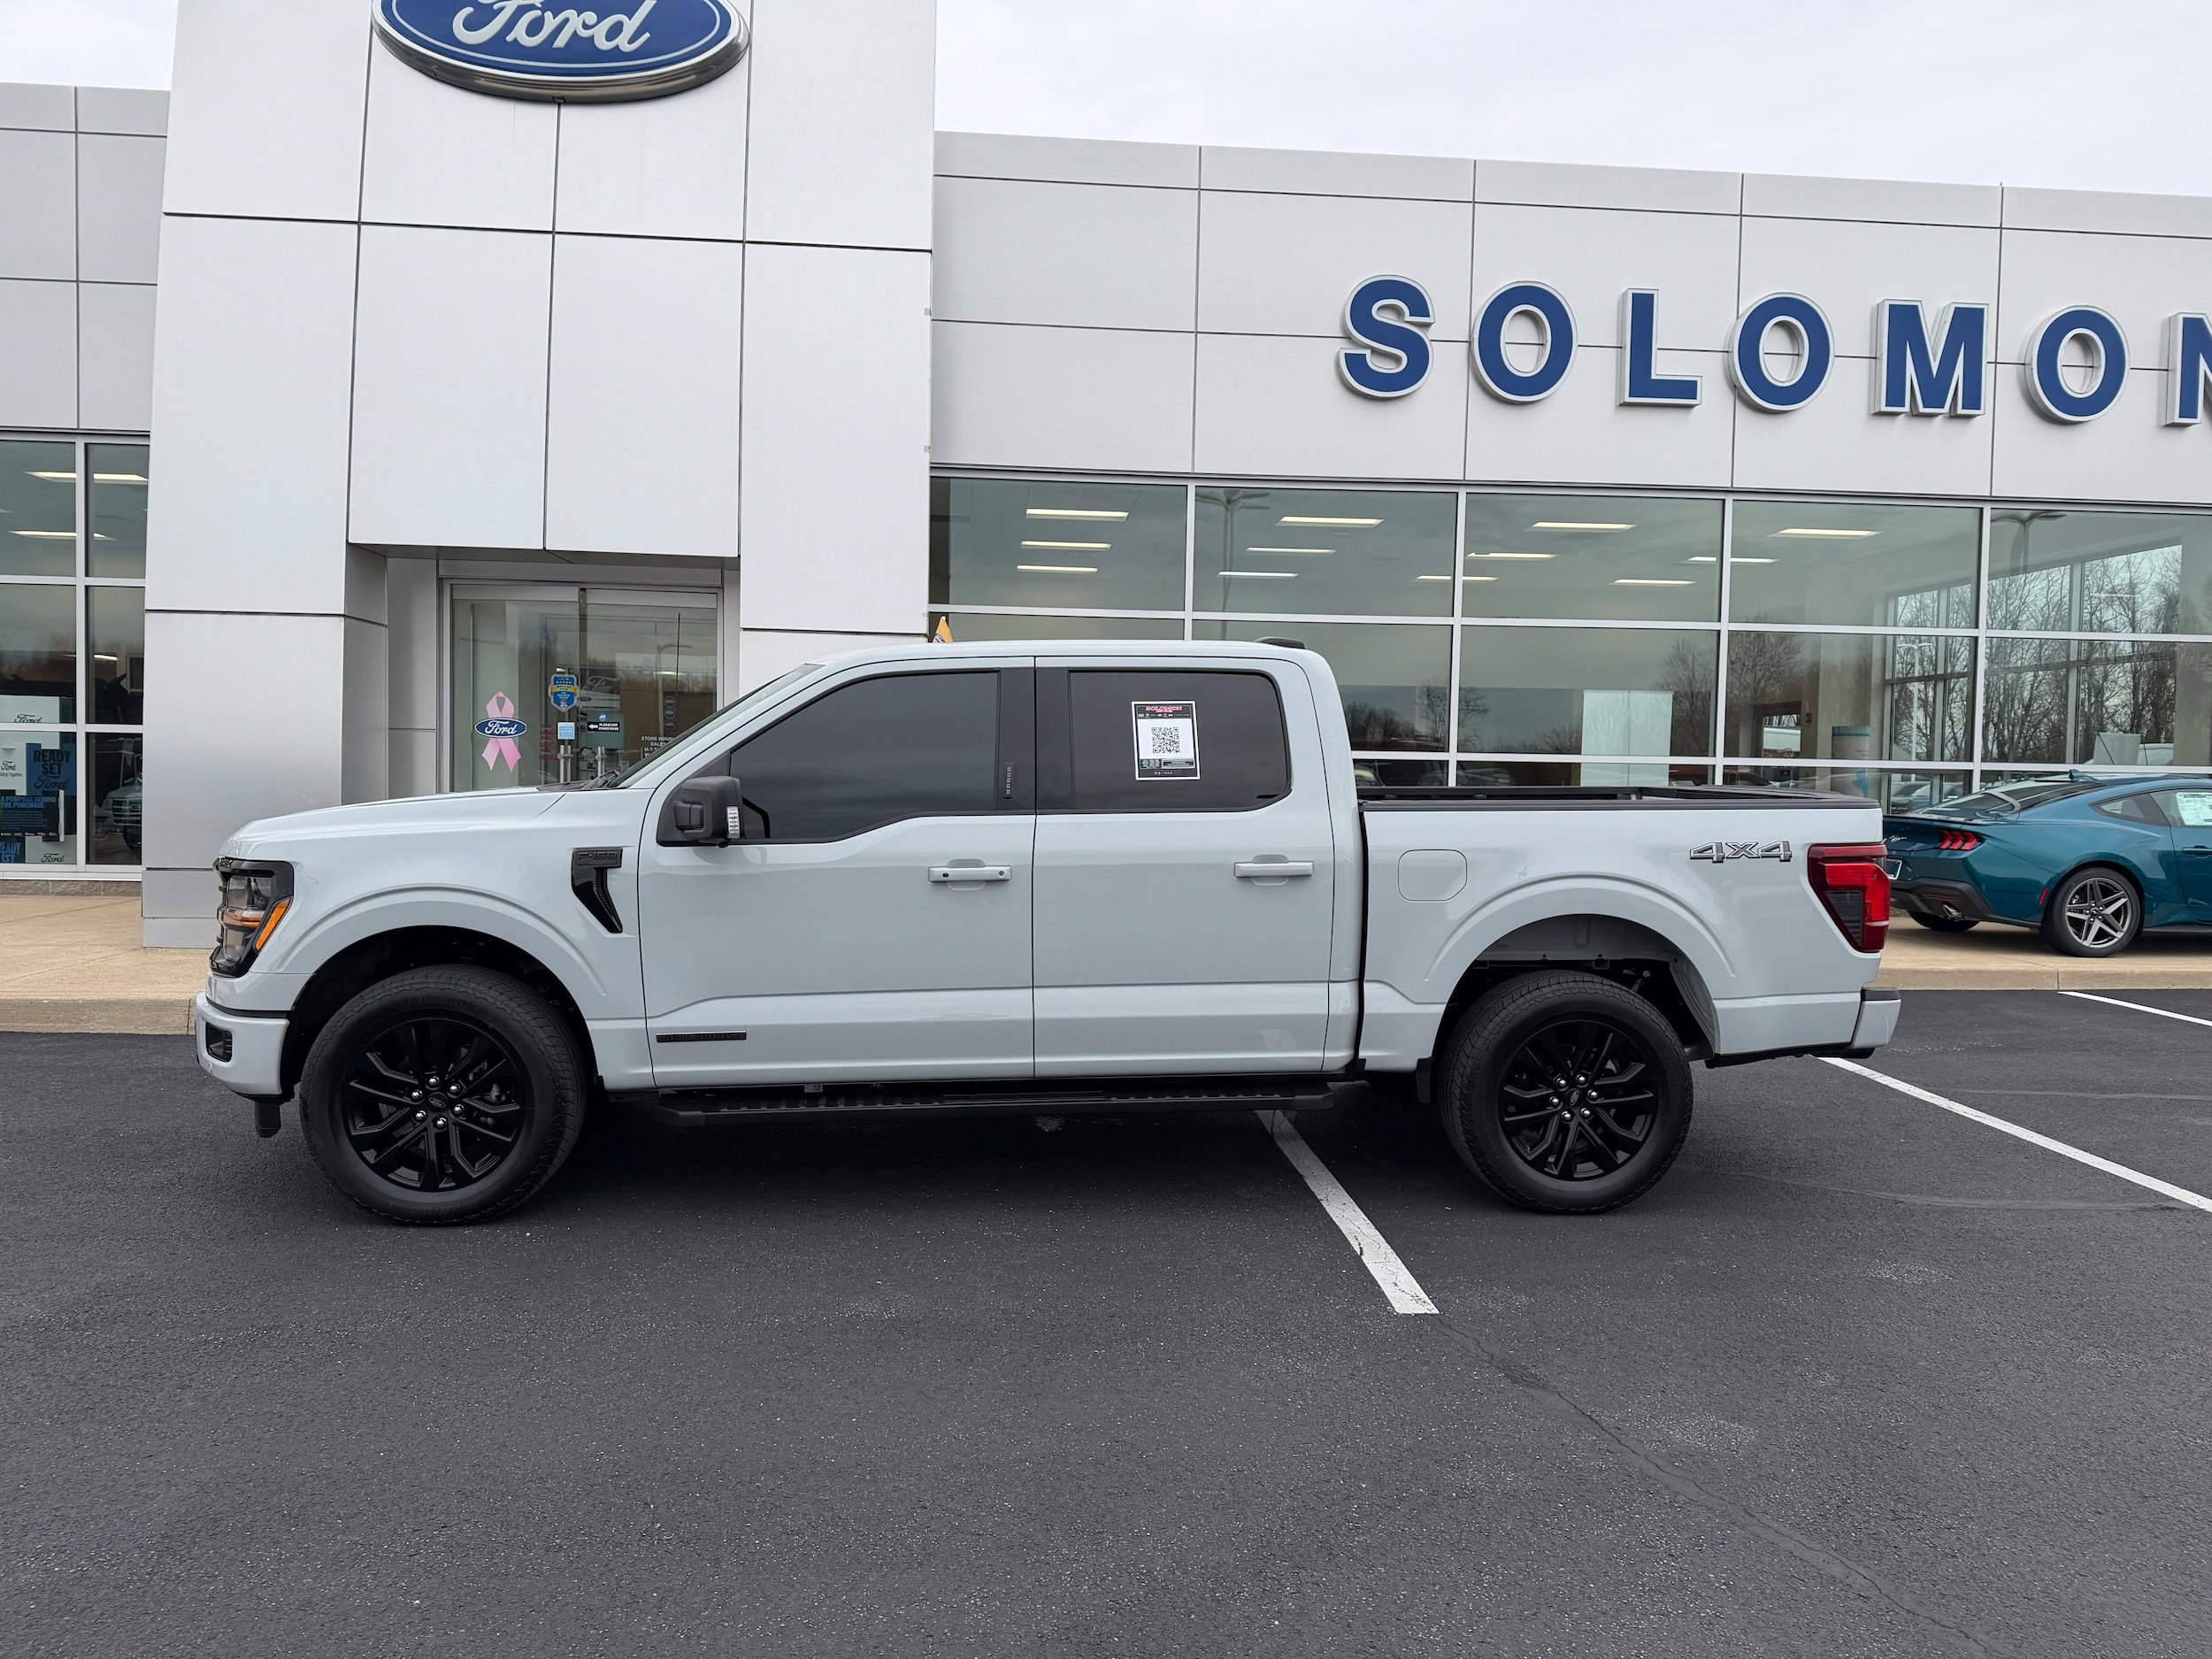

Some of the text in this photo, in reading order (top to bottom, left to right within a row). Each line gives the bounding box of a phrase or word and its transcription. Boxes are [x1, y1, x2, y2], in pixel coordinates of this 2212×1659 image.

[452, 0, 657, 53] Ford
[484, 719, 518, 734] Ford
[33, 749, 71, 763] READY
[42, 763, 62, 775] SET
[0, 841, 21, 855] EADY
[1, 854, 16, 864] SET
[41, 852, 65, 863] Ford
